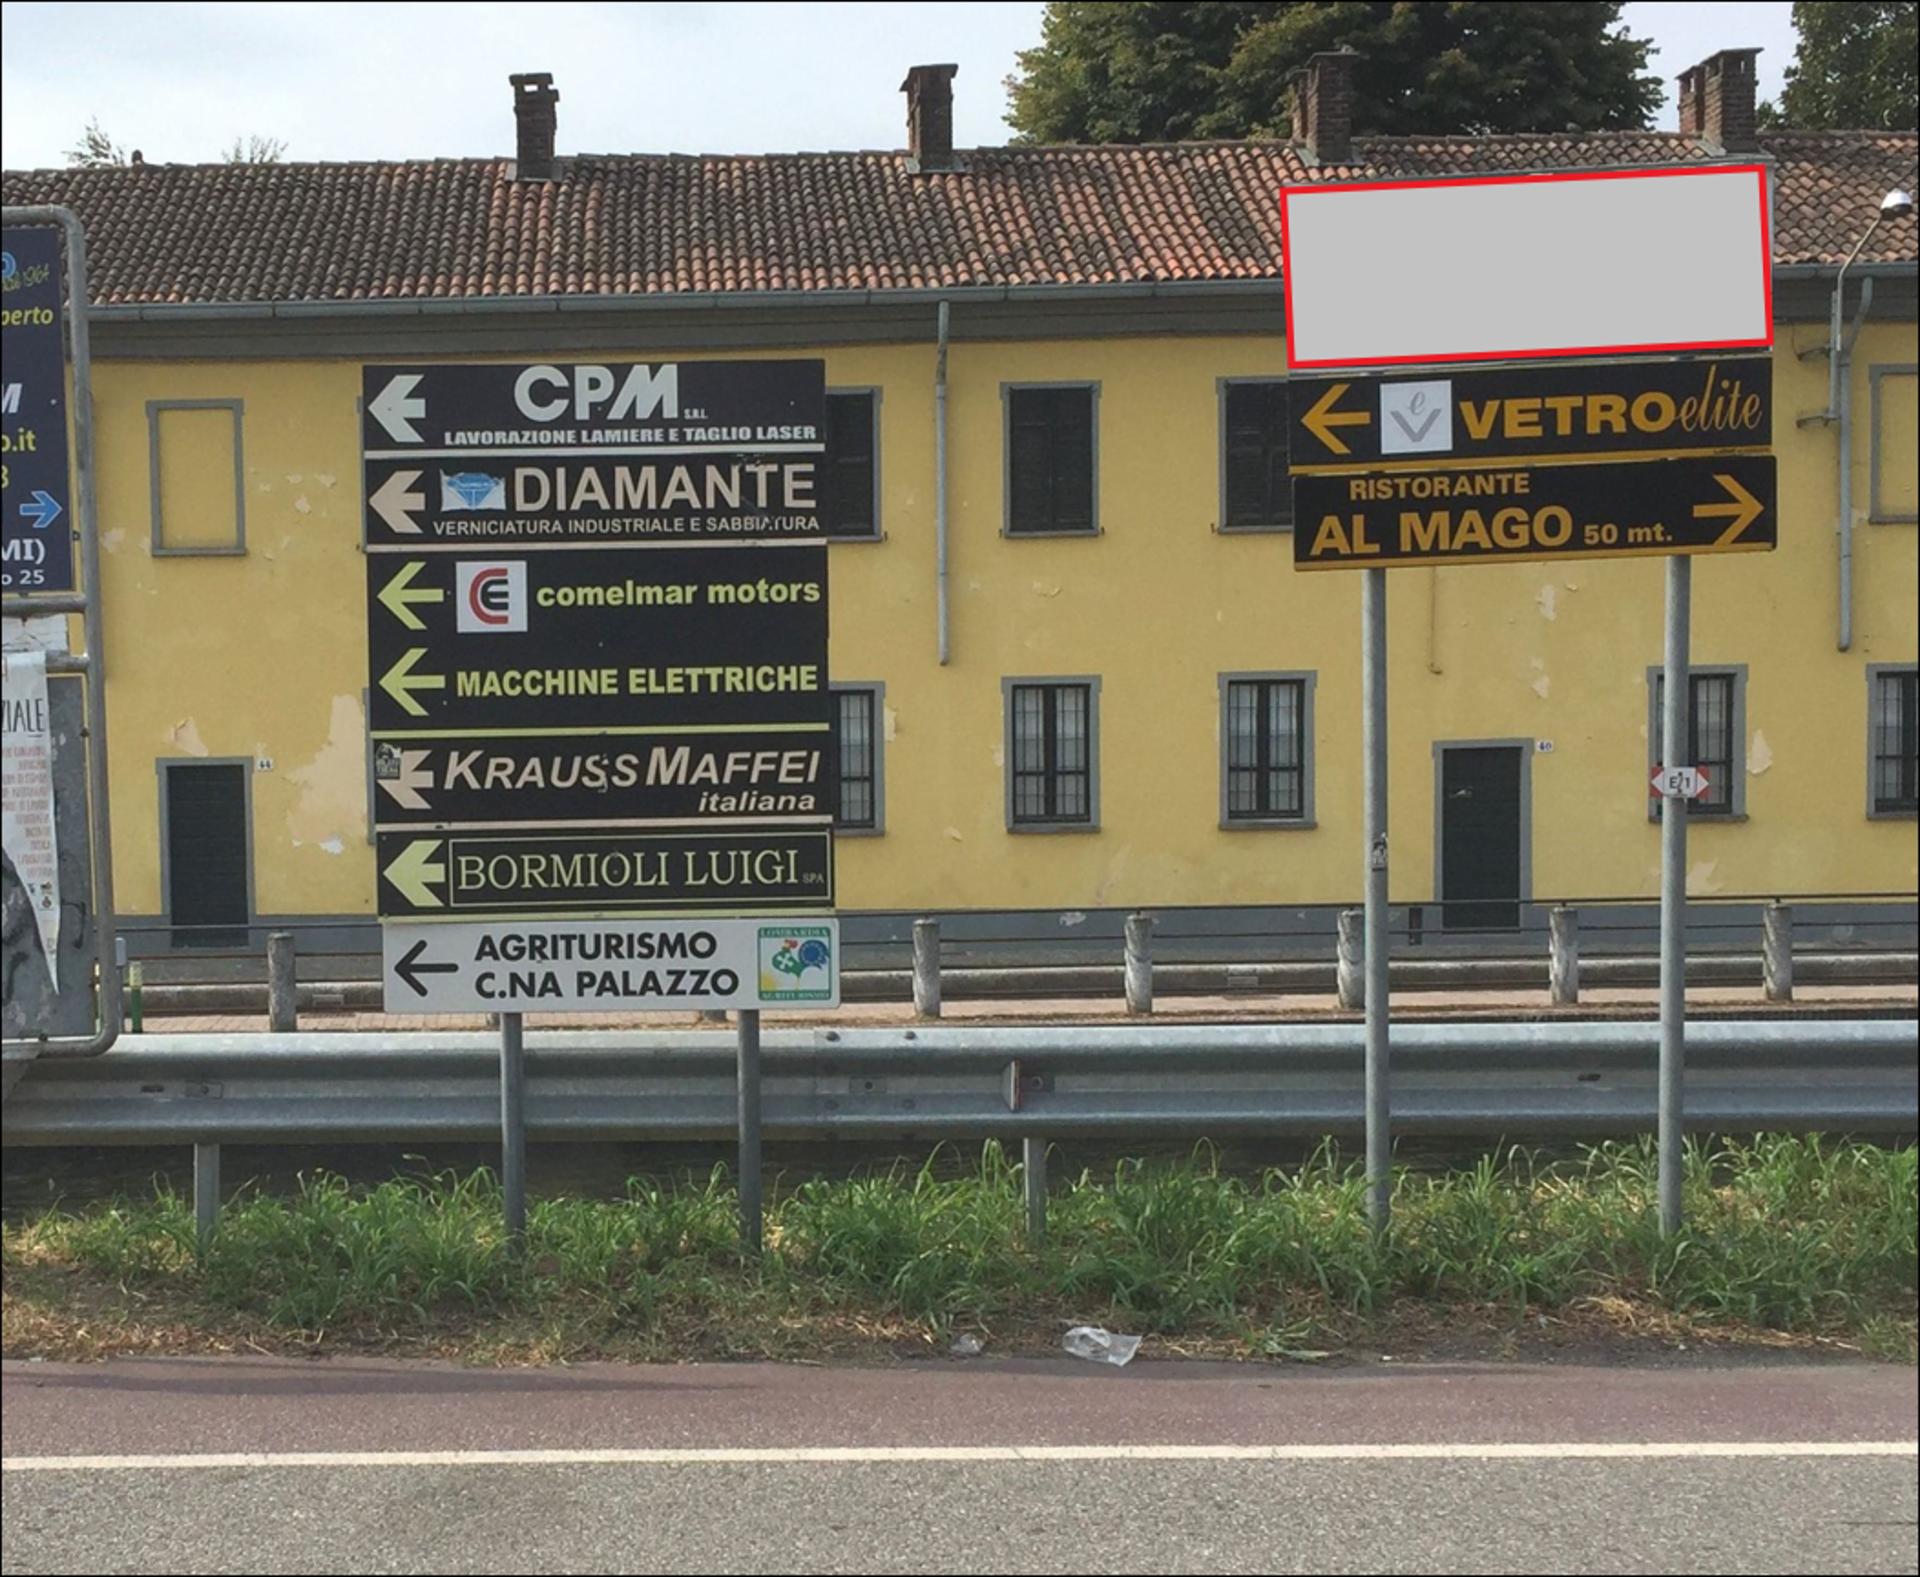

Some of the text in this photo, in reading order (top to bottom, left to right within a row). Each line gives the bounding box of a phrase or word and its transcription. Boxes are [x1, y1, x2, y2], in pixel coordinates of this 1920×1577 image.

[513, 364, 679, 422] CPM
[445, 424, 817, 446] LAVORAZIONE LAMIERE E TAGLIO LASER
[514, 463, 817, 512] DIAMANTE
[1349, 473, 1530, 501] RISTORANTE
[433, 515, 820, 536] VERNICIATURA INDUSTRIALE E SABBIATURA
[1310, 505, 1674, 556] AL MAGO 50 mt.
[20, 569, 45, 586] 25
[536, 578, 821, 607] comelmar motors
[457, 665, 818, 697] MACCHINE ELETTRICHE
[698, 790, 815, 812] italiana
[457, 853, 669, 890] BORMIOLI
[684, 849, 798, 886] LUIGI
[475, 931, 717, 962] AGRITURISMO
[475, 968, 740, 999] C.NA PALAZZO
